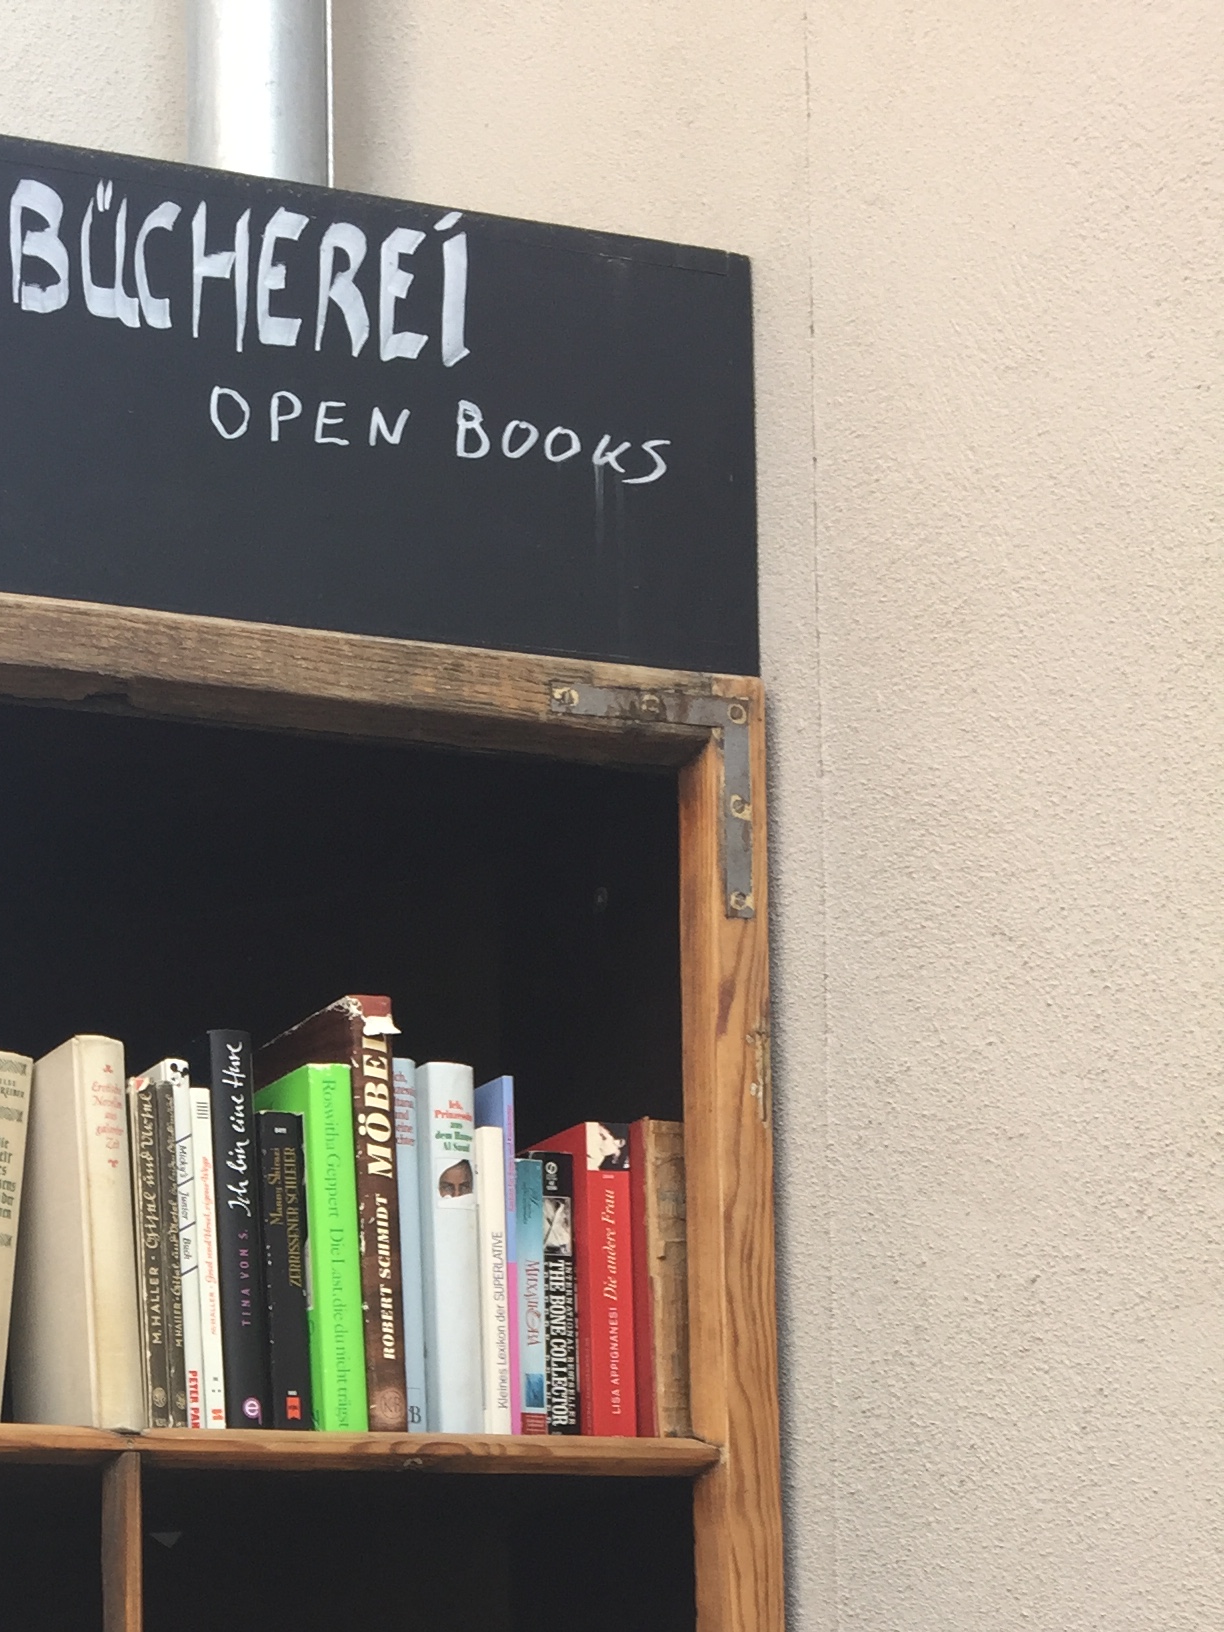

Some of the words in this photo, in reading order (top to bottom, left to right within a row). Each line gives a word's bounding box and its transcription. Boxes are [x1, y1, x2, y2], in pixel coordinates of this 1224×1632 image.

[208, 386, 411, 449] OPEN
[453, 399, 676, 483] BOOKS
[322, 1079, 340, 1150] Roswitha
[435, 1131, 452, 1139] dem
[454, 1131, 473, 1140] Hause
[283, 1147, 299, 1204] SCHLEIER
[323, 1153, 341, 1218] Geppert
[600, 1188, 617, 1225] Frau
[183, 1236, 192, 1260] Buch
[238, 1229, 248, 1240] S.
[285, 1207, 303, 1288] ZERRISSENER
[376, 1193, 393, 1279] SCHMIDT
[602, 1227, 619, 1274] andere
[239, 1249, 250, 1279] VON
[490, 1231, 505, 1302] SUPERLATIVE
[547, 1259, 567, 1292] THE
[149, 1266, 162, 1327] HALLER
[241, 1288, 252, 1326] TINA
[602, 1275, 619, 1301] Die
[379, 1284, 396, 1360] ROBERT
[548, 1294, 568, 1336] BONE
[495, 1325, 507, 1365] Lexikon
[608, 1307, 621, 1385] APPIGNANESI
[187, 1370, 200, 1404] PETER
[495, 1366, 509, 1409] Kleines
[550, 1338, 570, 1427] COLLECTOR
[611, 1389, 622, 1415] LISA
